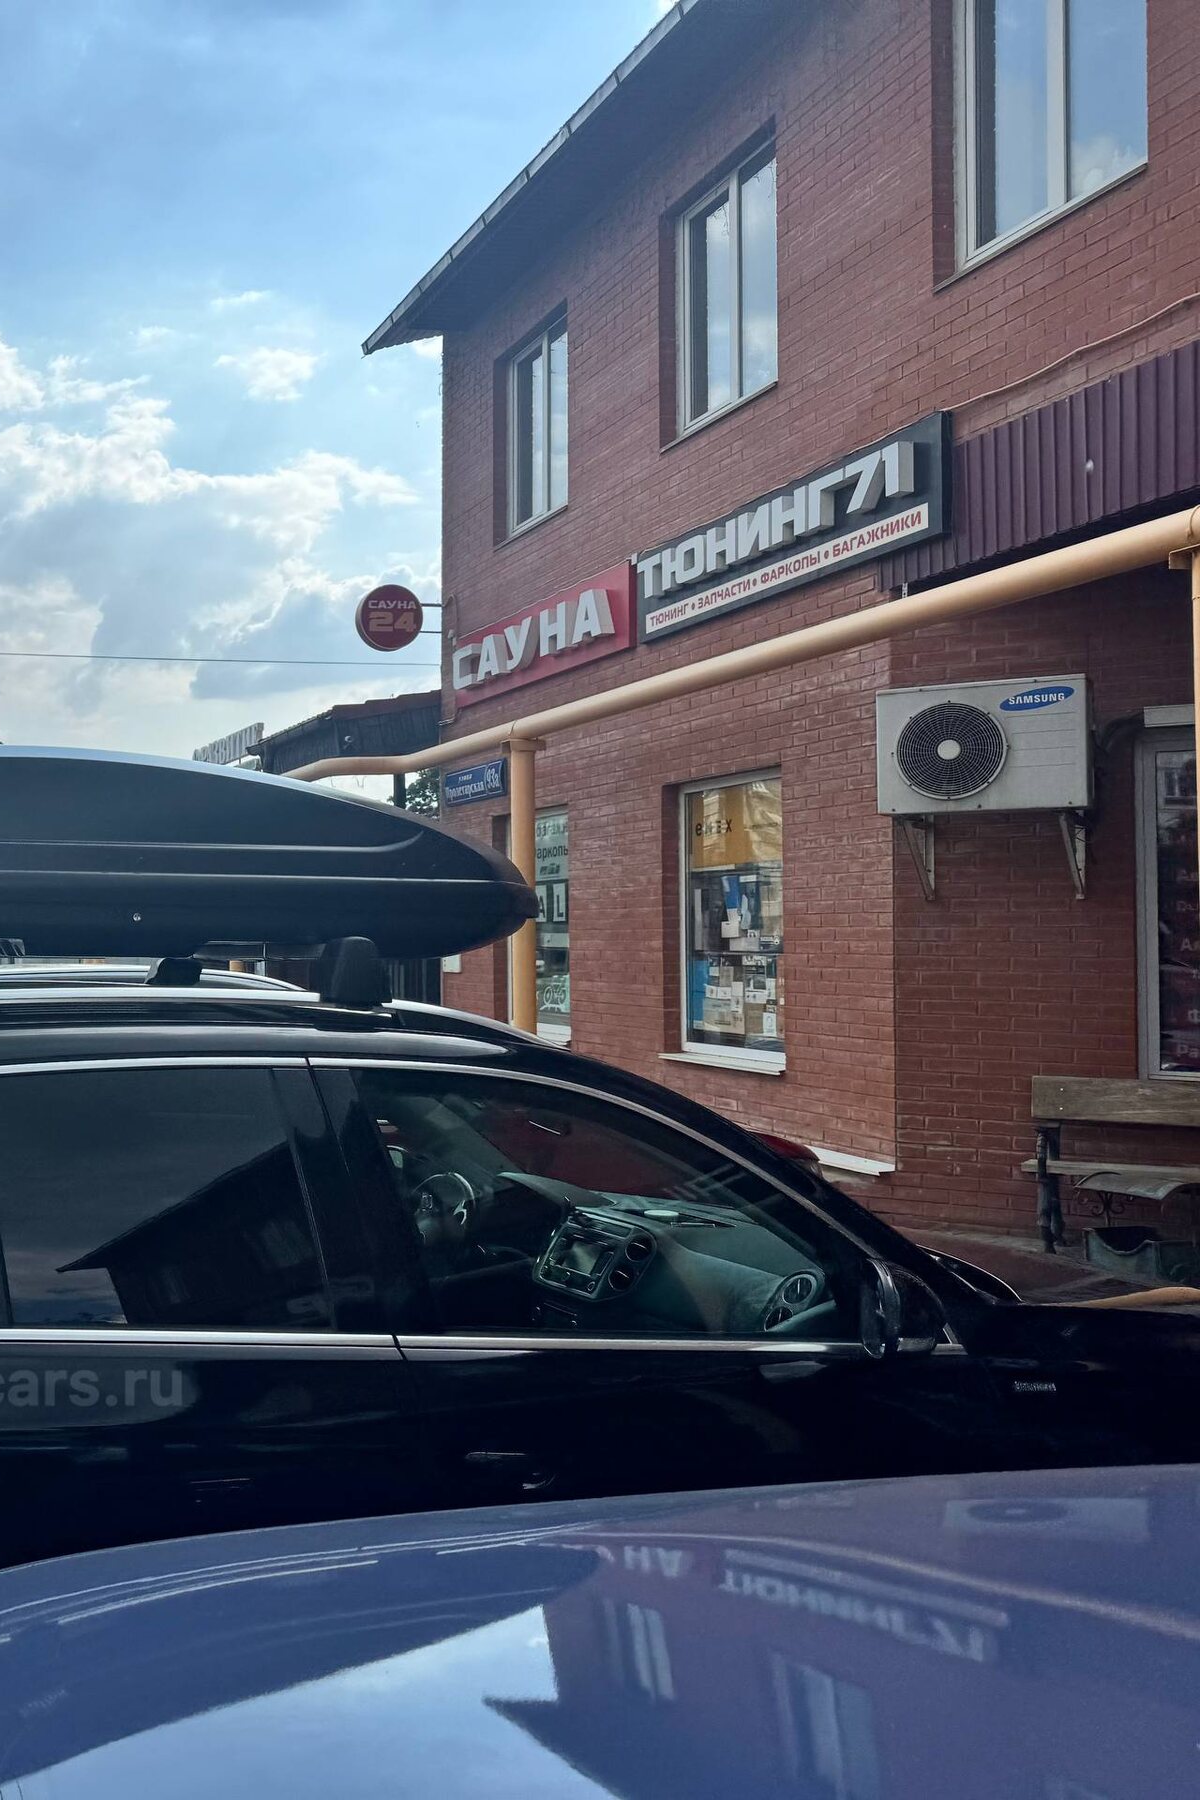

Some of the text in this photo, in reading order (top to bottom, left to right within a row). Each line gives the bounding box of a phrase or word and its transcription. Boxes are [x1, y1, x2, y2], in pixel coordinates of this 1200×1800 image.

[637, 441, 914, 599] ТЮНИНГ71
[649, 510, 922, 627] ТЮНИНГ ЗАПЧАСТИ ФАРКОПЫ БАГАЖНИКИ
[368, 600, 417, 610] САУНА
[368, 611, 417, 633] 24
[452, 588, 615, 690] САУНА
[1008, 692, 1065, 705] SAMSUNG
